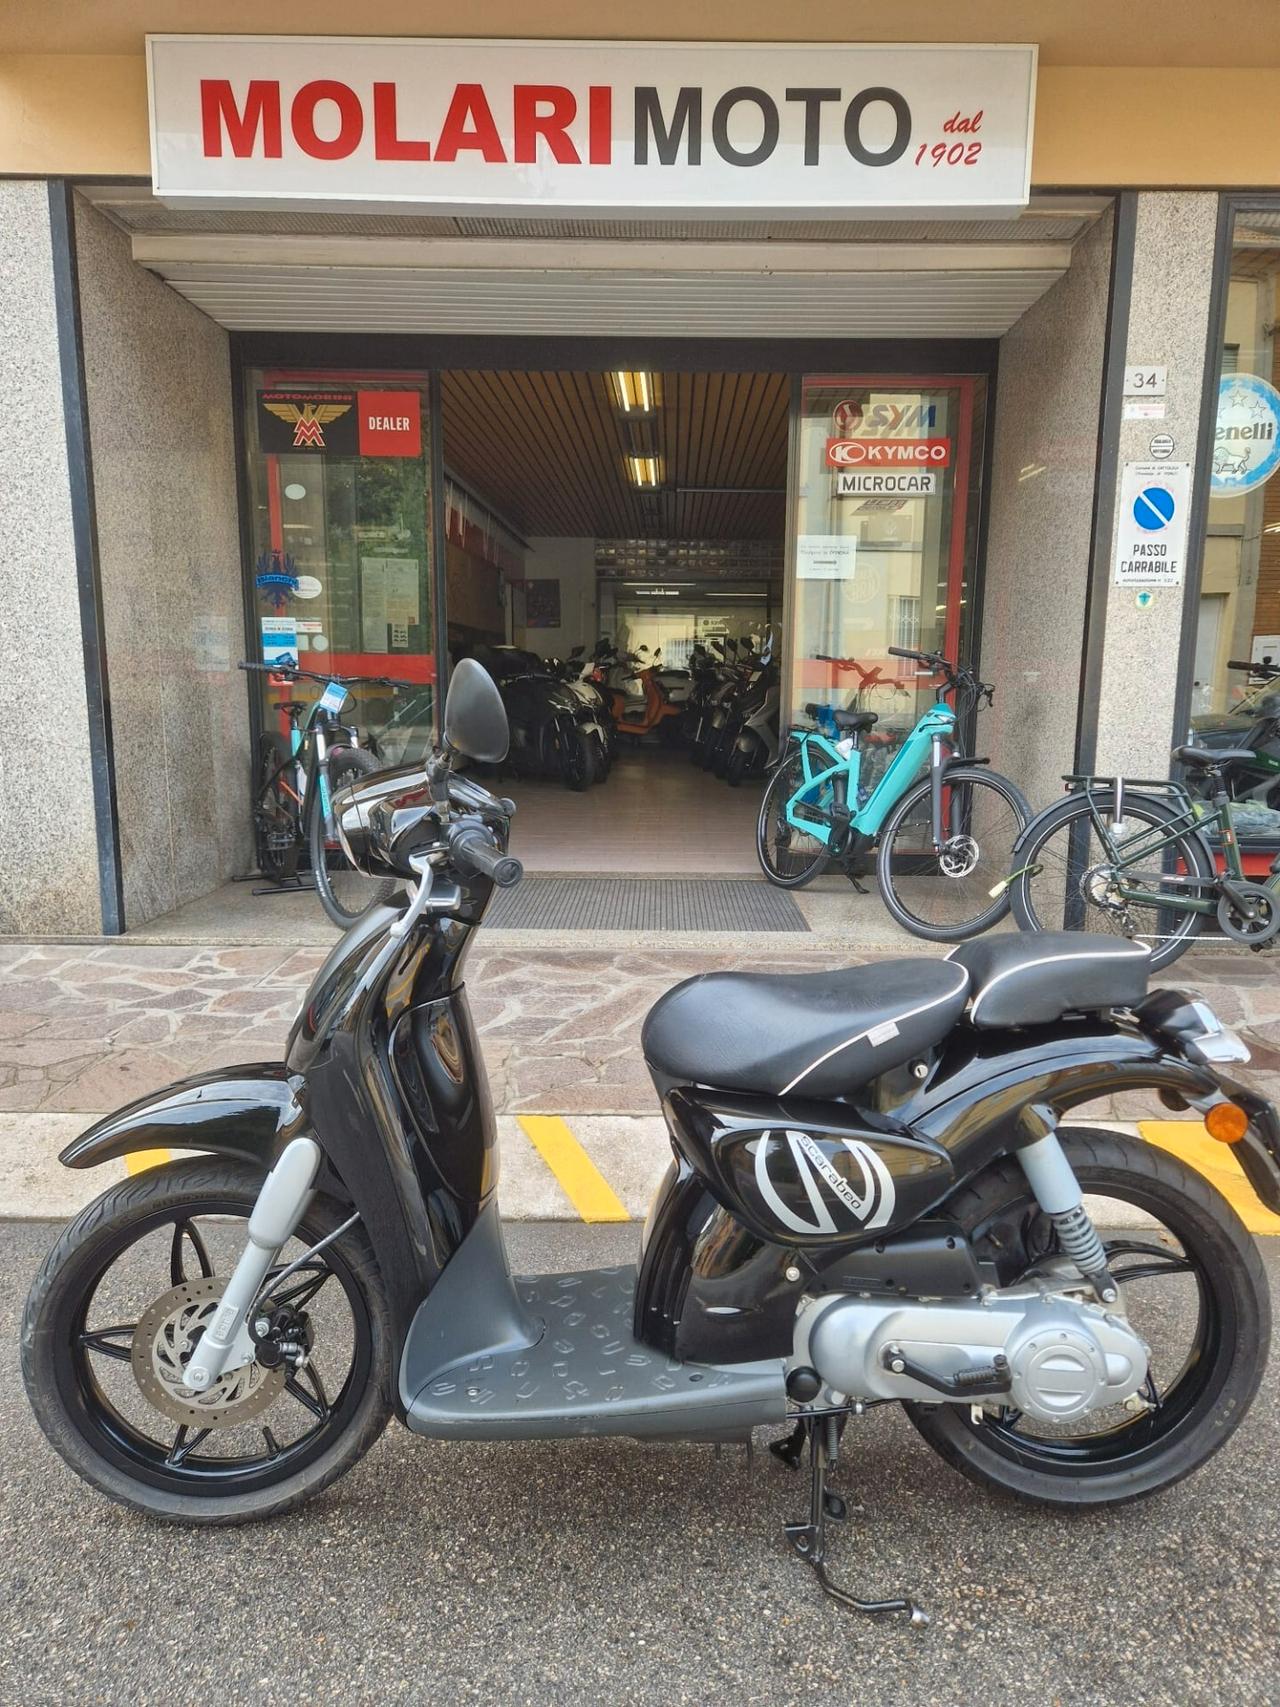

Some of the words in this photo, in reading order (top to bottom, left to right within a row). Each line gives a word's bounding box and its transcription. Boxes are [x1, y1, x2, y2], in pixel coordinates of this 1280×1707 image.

[200, 79, 612, 166] MOLARI
[633, 85, 913, 168] MOTO
[942, 108, 983, 135] dal
[914, 139, 982, 168] 1902
[1132, 372, 1158, 389] 34
[368, 416, 410, 431] DEALER
[866, 404, 937, 430] SYM
[868, 445, 946, 460] KYMCO
[842, 475, 931, 492] MICROCAR
[1133, 543, 1167, 556] PASSO
[1120, 560, 1178, 574] CARRABILE
[799, 1135, 862, 1210] scarabeo
